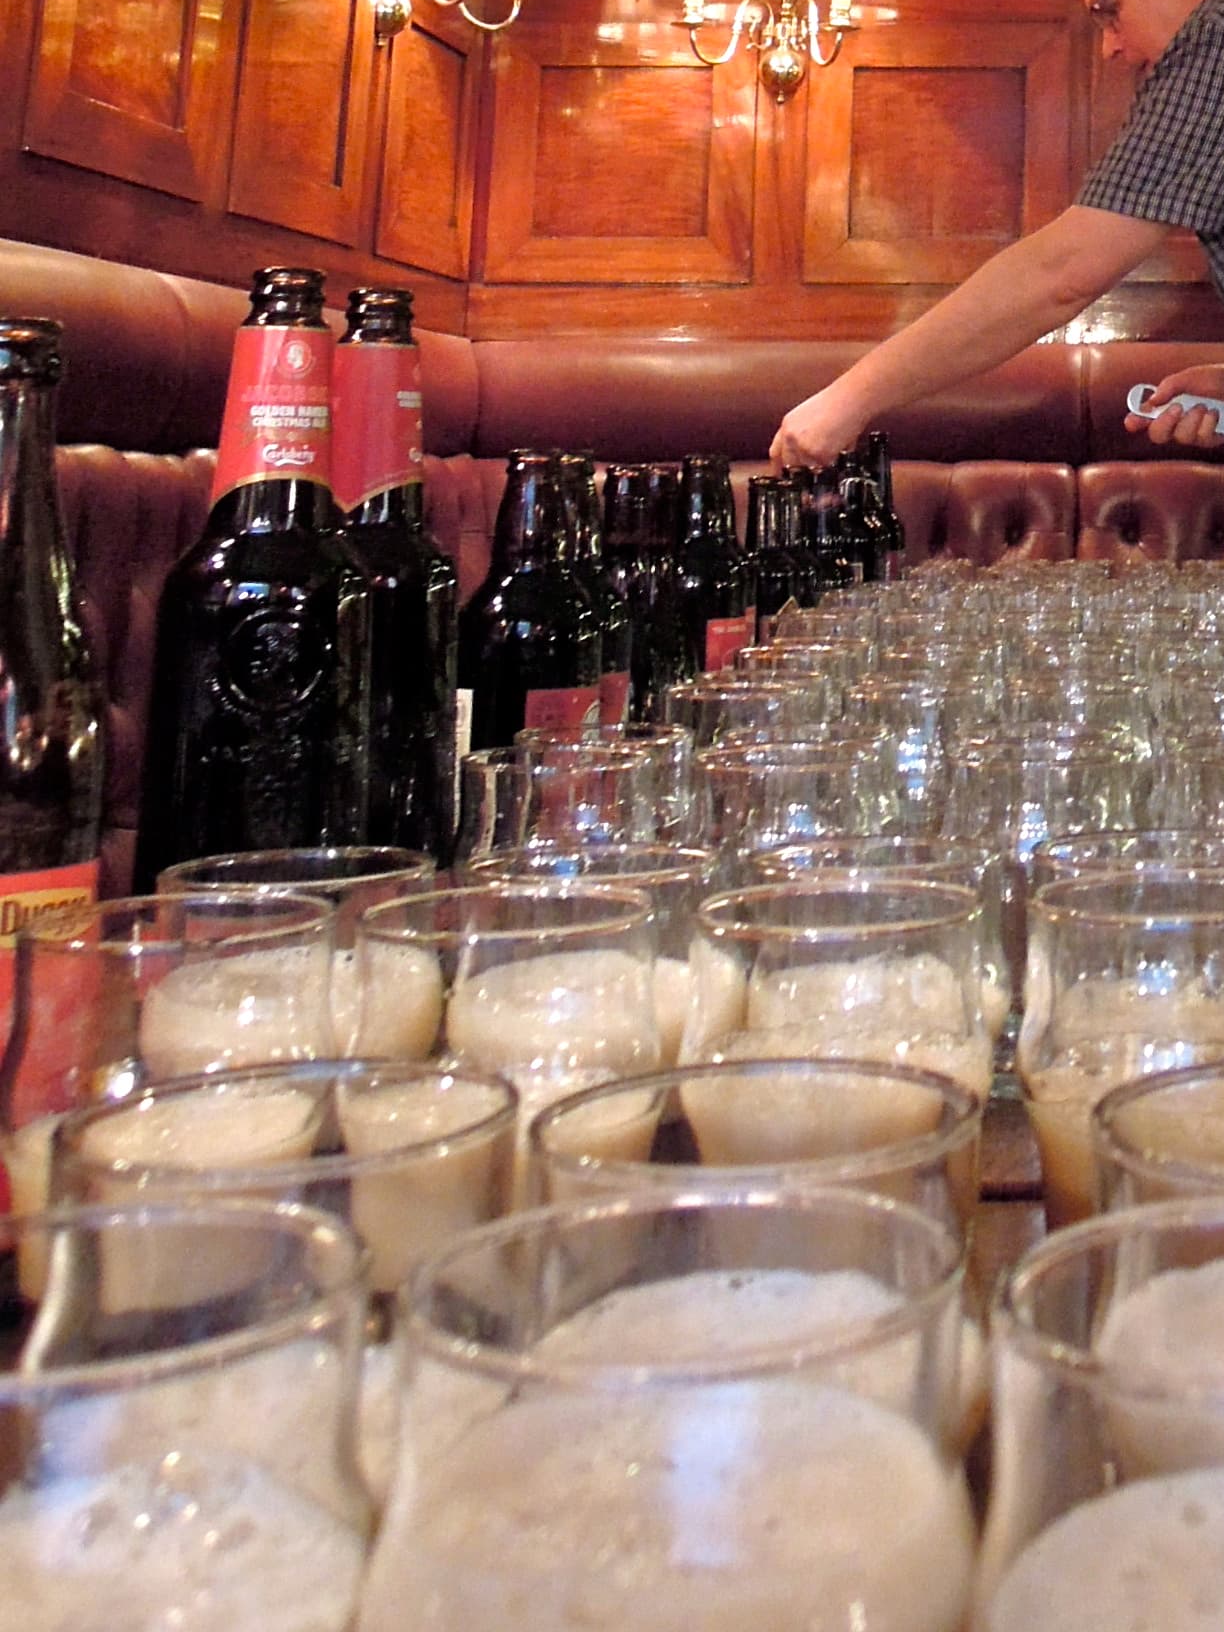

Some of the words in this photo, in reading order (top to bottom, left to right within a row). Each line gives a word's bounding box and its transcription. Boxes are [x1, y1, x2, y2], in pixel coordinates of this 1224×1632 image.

[250, 405, 295, 417] GOLDEN
[252, 417, 311, 428] CHRISTMAS
[262, 443, 316, 466] Carlsberg
